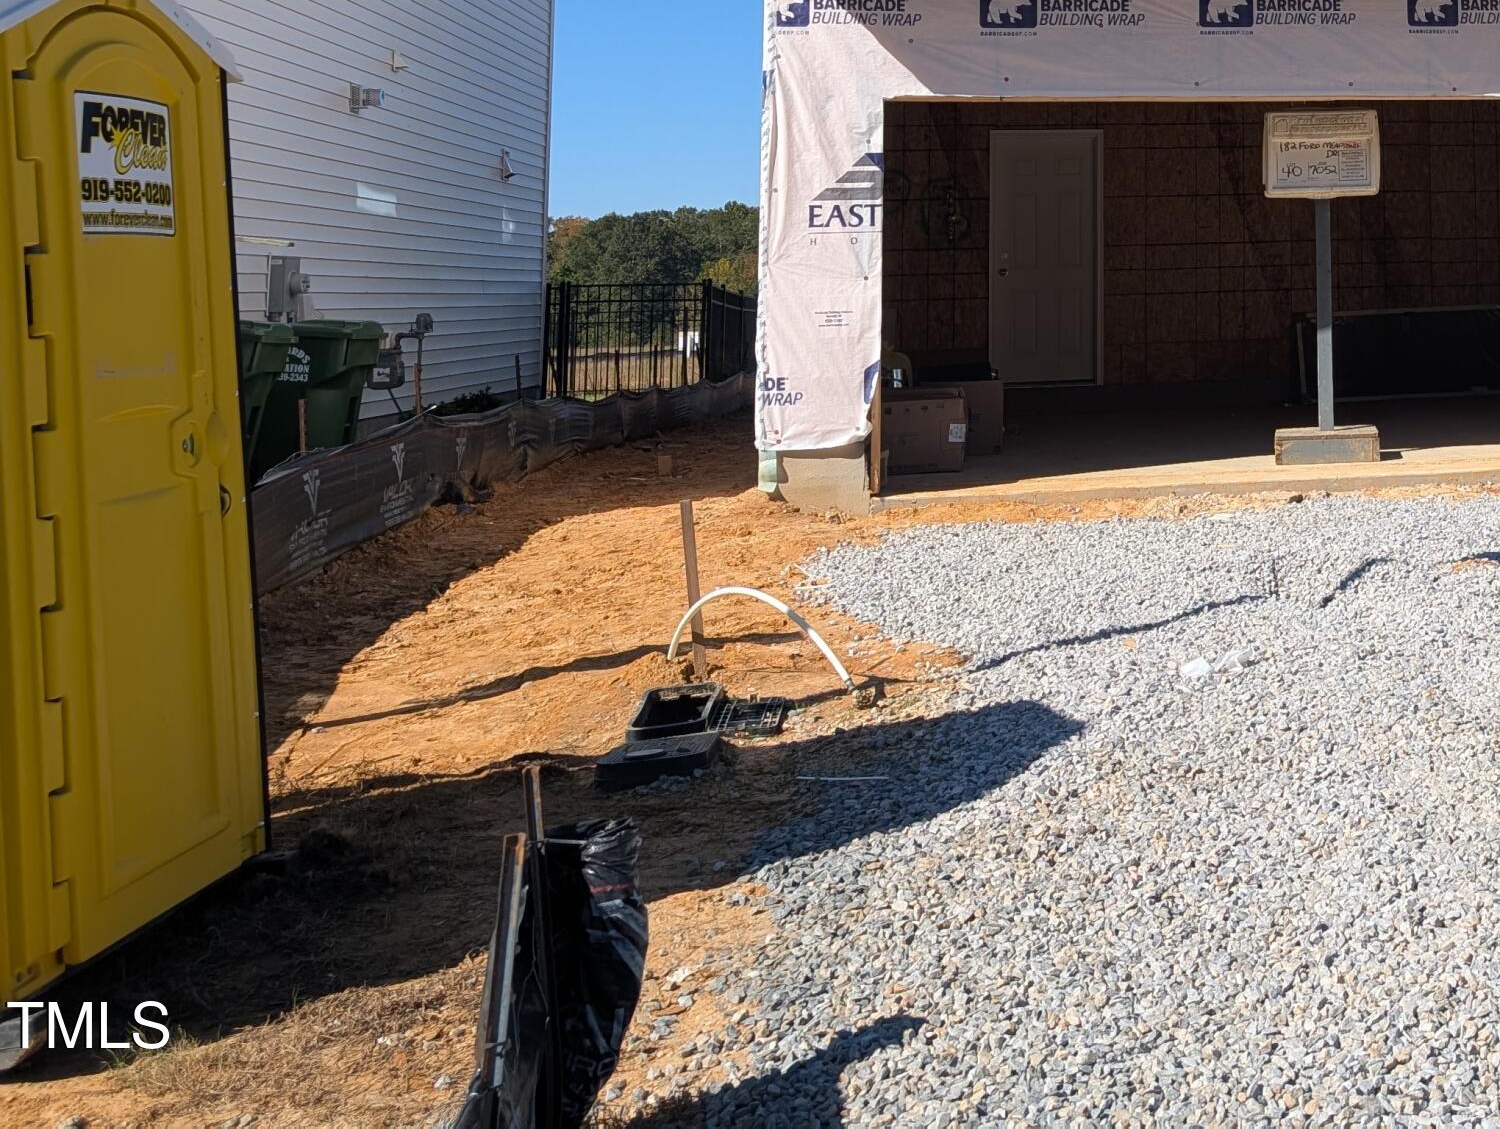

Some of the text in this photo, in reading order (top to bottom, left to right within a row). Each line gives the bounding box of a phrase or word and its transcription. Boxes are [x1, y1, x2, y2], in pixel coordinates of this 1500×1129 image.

[1041, 0, 1130, 13] BARRICADE
[1256, 0, 1341, 11] BARRICADE
[812, 12, 922, 27] BUILDING WRAP
[1039, 13, 1145, 27] BUILDING WRAP
[1255, 12, 1356, 25] BUILDING WRAP
[82, 101, 166, 153] FOREVER
[114, 128, 168, 175] Clean
[1282, 165, 1338, 178] 40 7052
[82, 177, 172, 207] 919-552-0200
[808, 203, 882, 228] EAST
[284, 363, 310, 373] ATION
[761, 392, 804, 406] WRAP
